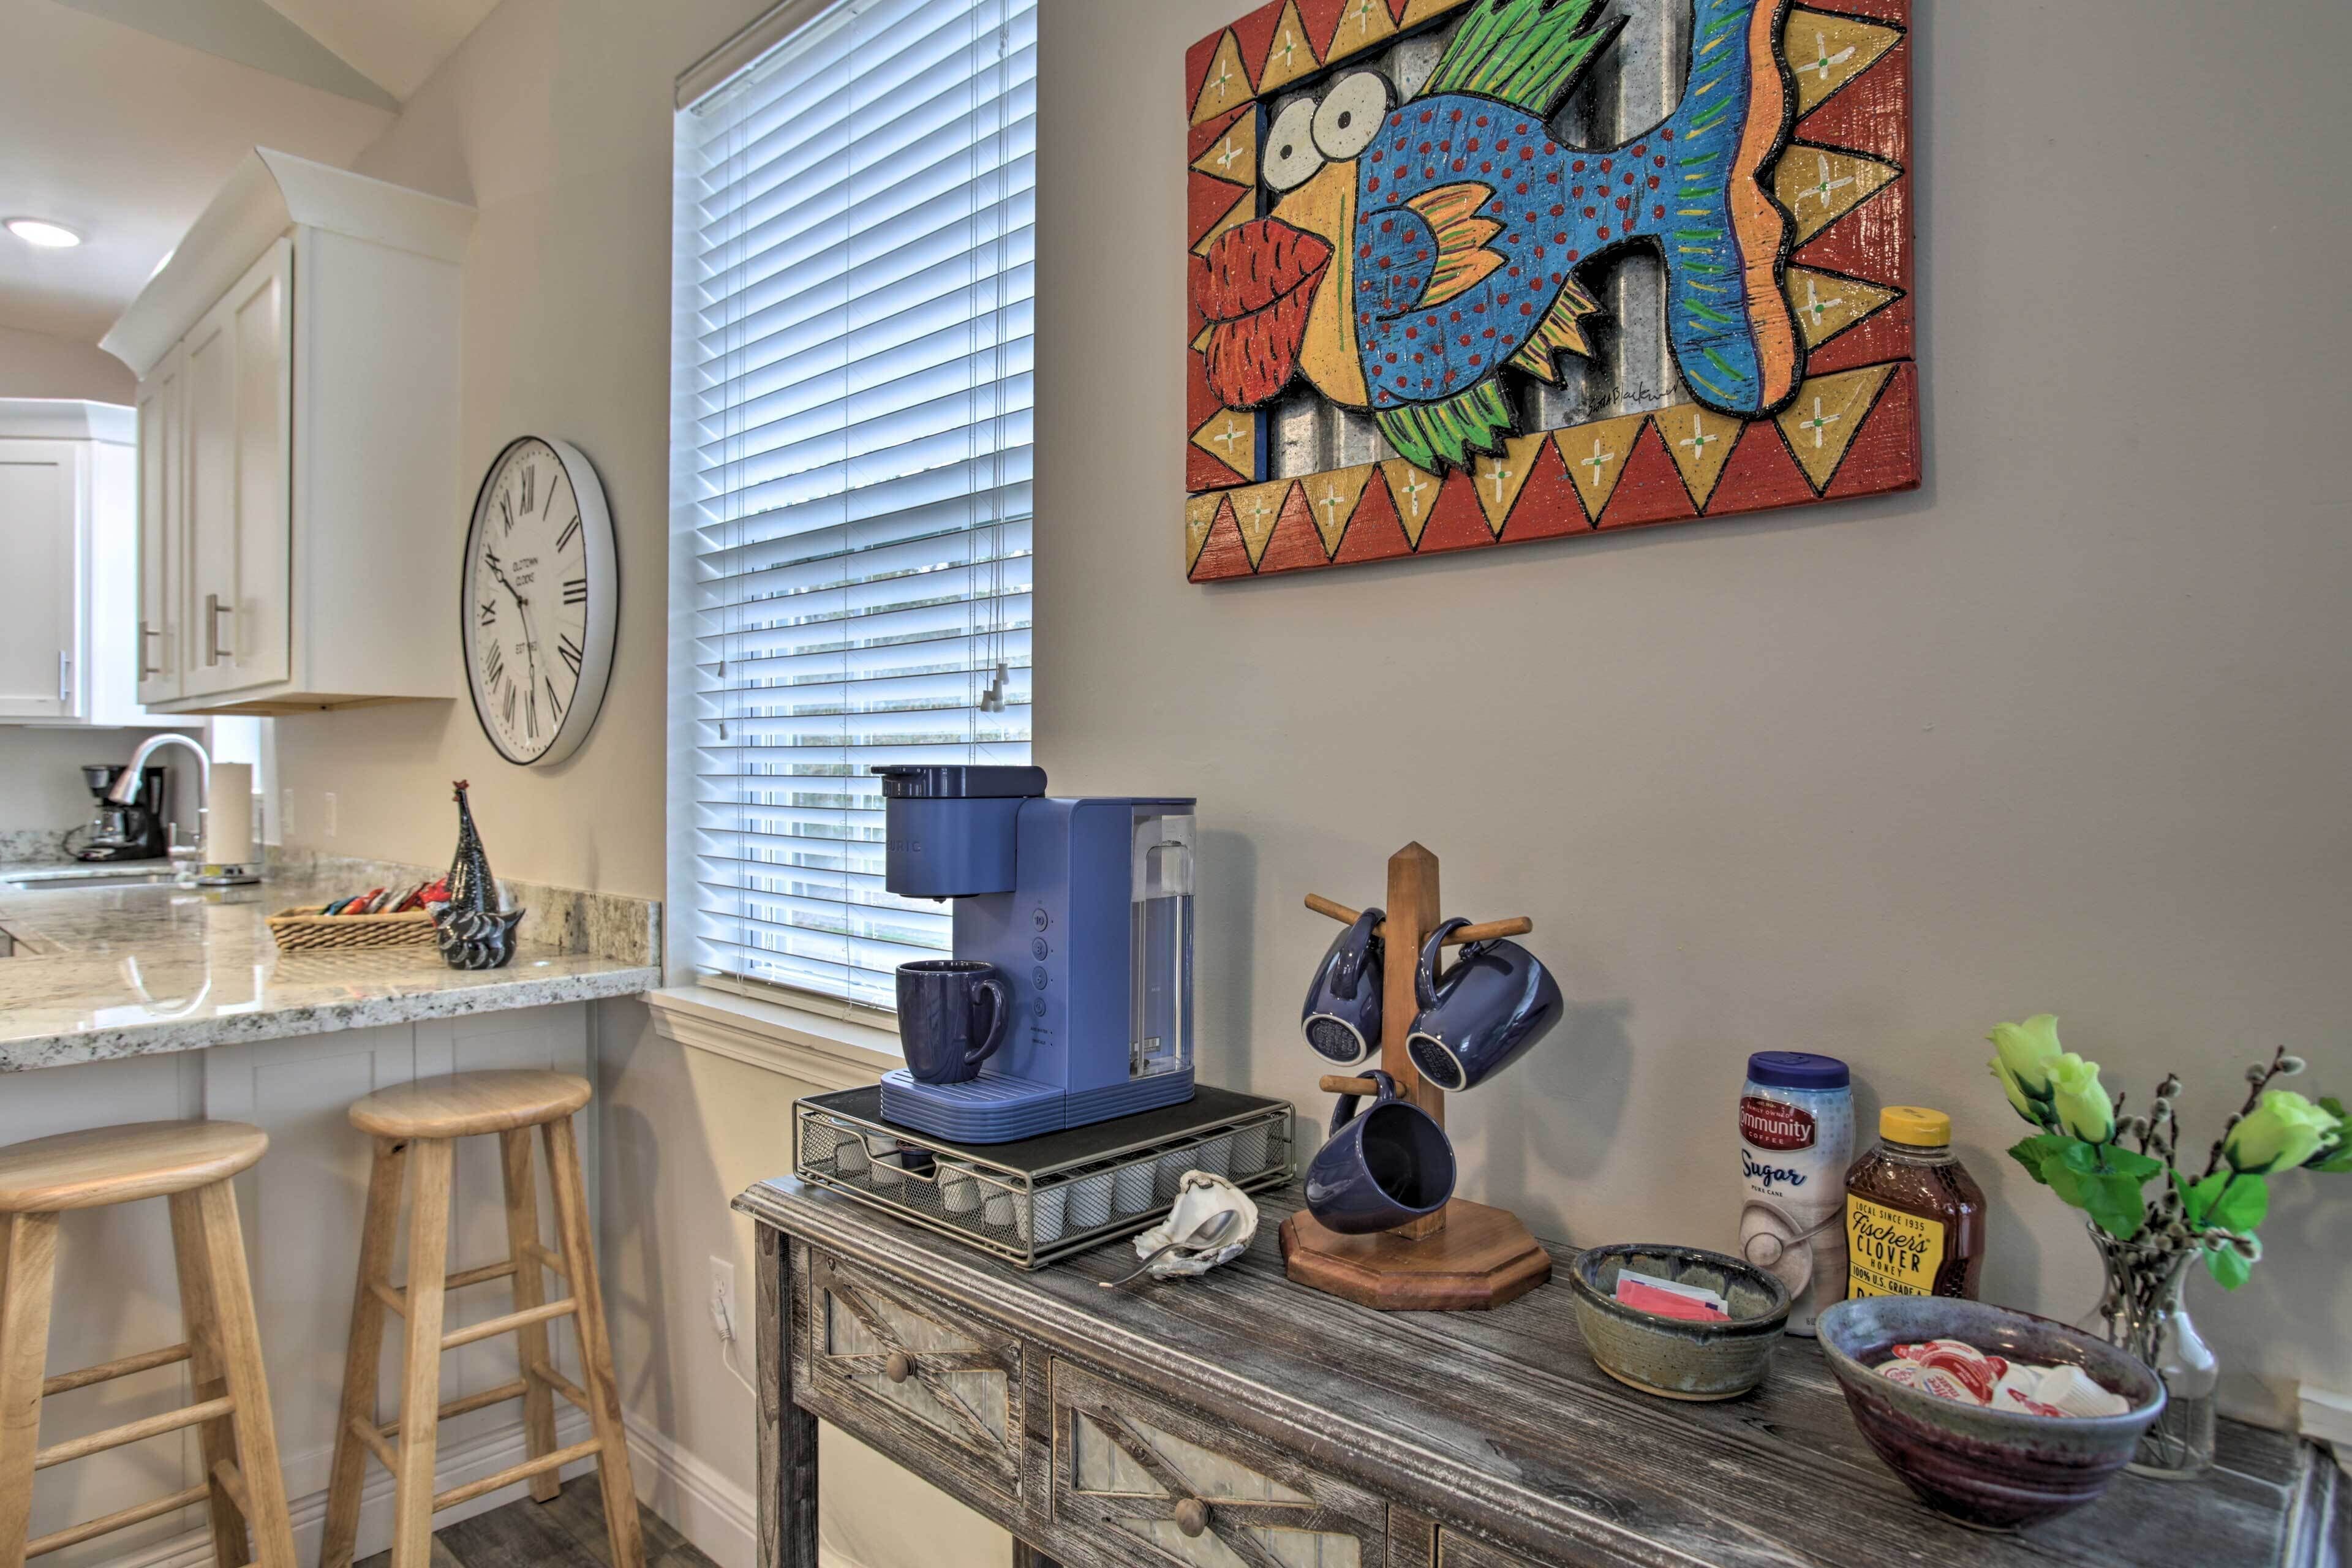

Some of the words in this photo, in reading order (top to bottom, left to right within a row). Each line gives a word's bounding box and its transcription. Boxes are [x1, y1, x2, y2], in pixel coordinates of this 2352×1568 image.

[519, 464, 535, 516] XII
[555, 513, 579, 554] II
[563, 578, 587, 606] III
[481, 598, 496, 627] IX
[1740, 1106, 1812, 1142] Community
[1749, 1131, 1784, 1145] COFFEE
[1741, 1148, 1807, 1187] Sugar
[1751, 1184, 1766, 1194] PURE
[1766, 1189, 1784, 1197] CANE
[1856, 1201, 1876, 1216] LOCAL
[1880, 1210, 1902, 1225] SINCE
[1905, 1218, 1925, 1231] 1935
[1857, 1234, 1920, 1273] CLOVER
[1871, 1258, 1902, 1278] HONEY
[1853, 1265, 1871, 1282] 100%
[1872, 1275, 1887, 1288] U.S.
